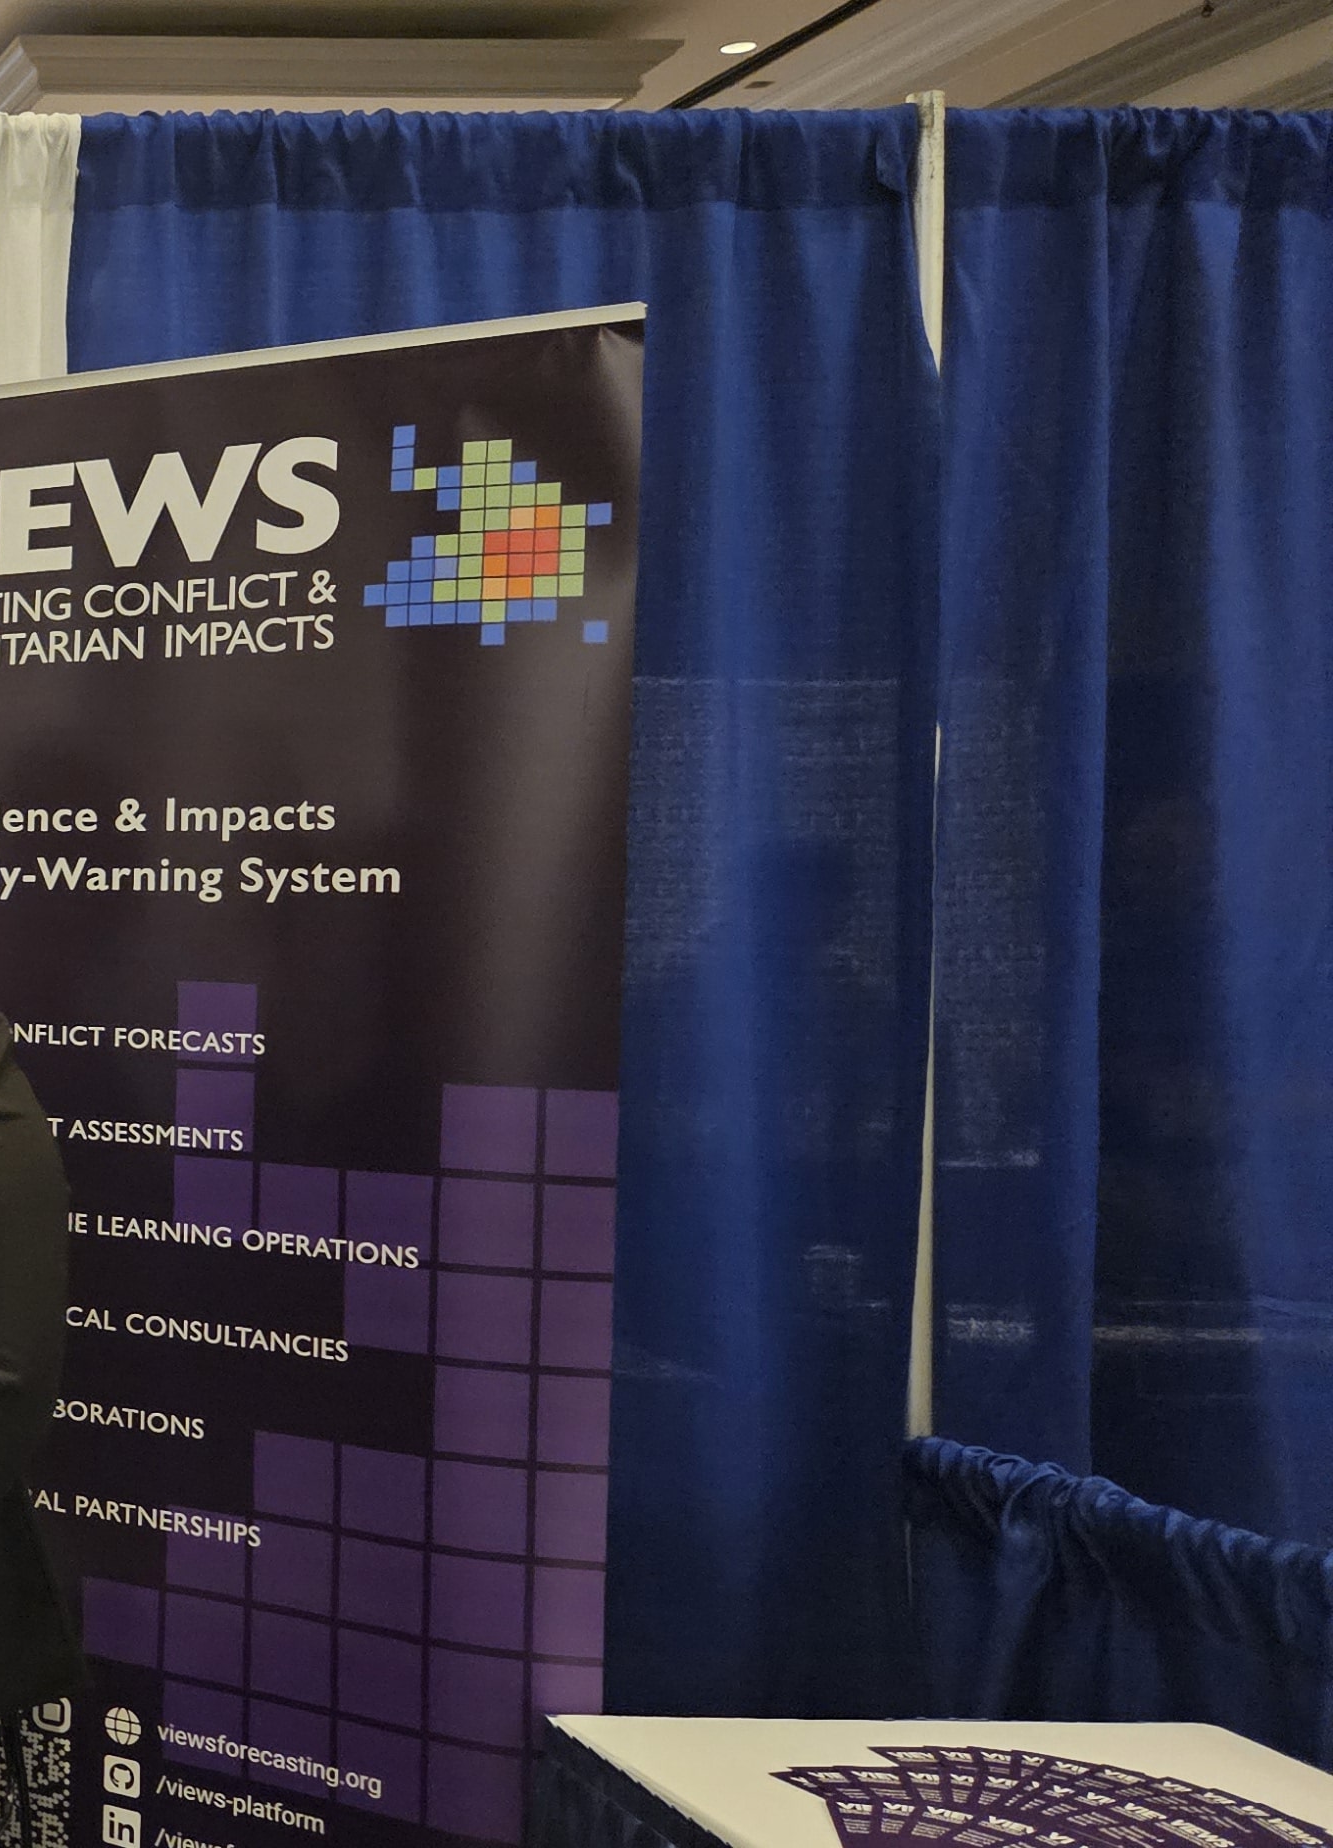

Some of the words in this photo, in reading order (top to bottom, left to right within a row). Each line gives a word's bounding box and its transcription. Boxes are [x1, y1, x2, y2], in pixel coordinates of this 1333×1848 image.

[84, 572, 299, 620] CONFLICT
[308, 570, 336, 604] &
[165, 614, 333, 657] IMPACTS
[115, 799, 146, 832] &
[166, 798, 335, 841] Impacts
[241, 857, 400, 903] System
[10, 1023, 105, 1047] NFLICT
[114, 1027, 265, 1056] FORECASTS
[69, 1120, 243, 1151] ASSESSMENTS
[98, 1215, 231, 1247] LEARNING
[242, 1230, 418, 1268] OPERATIONS
[126, 1314, 348, 1361] CONSULTANCIES
[76, 1496, 260, 1547] PARTNERSHIPS
[157, 1724, 382, 1799] viewsforecasting.org
[156, 1776, 324, 1835] /views-platform
